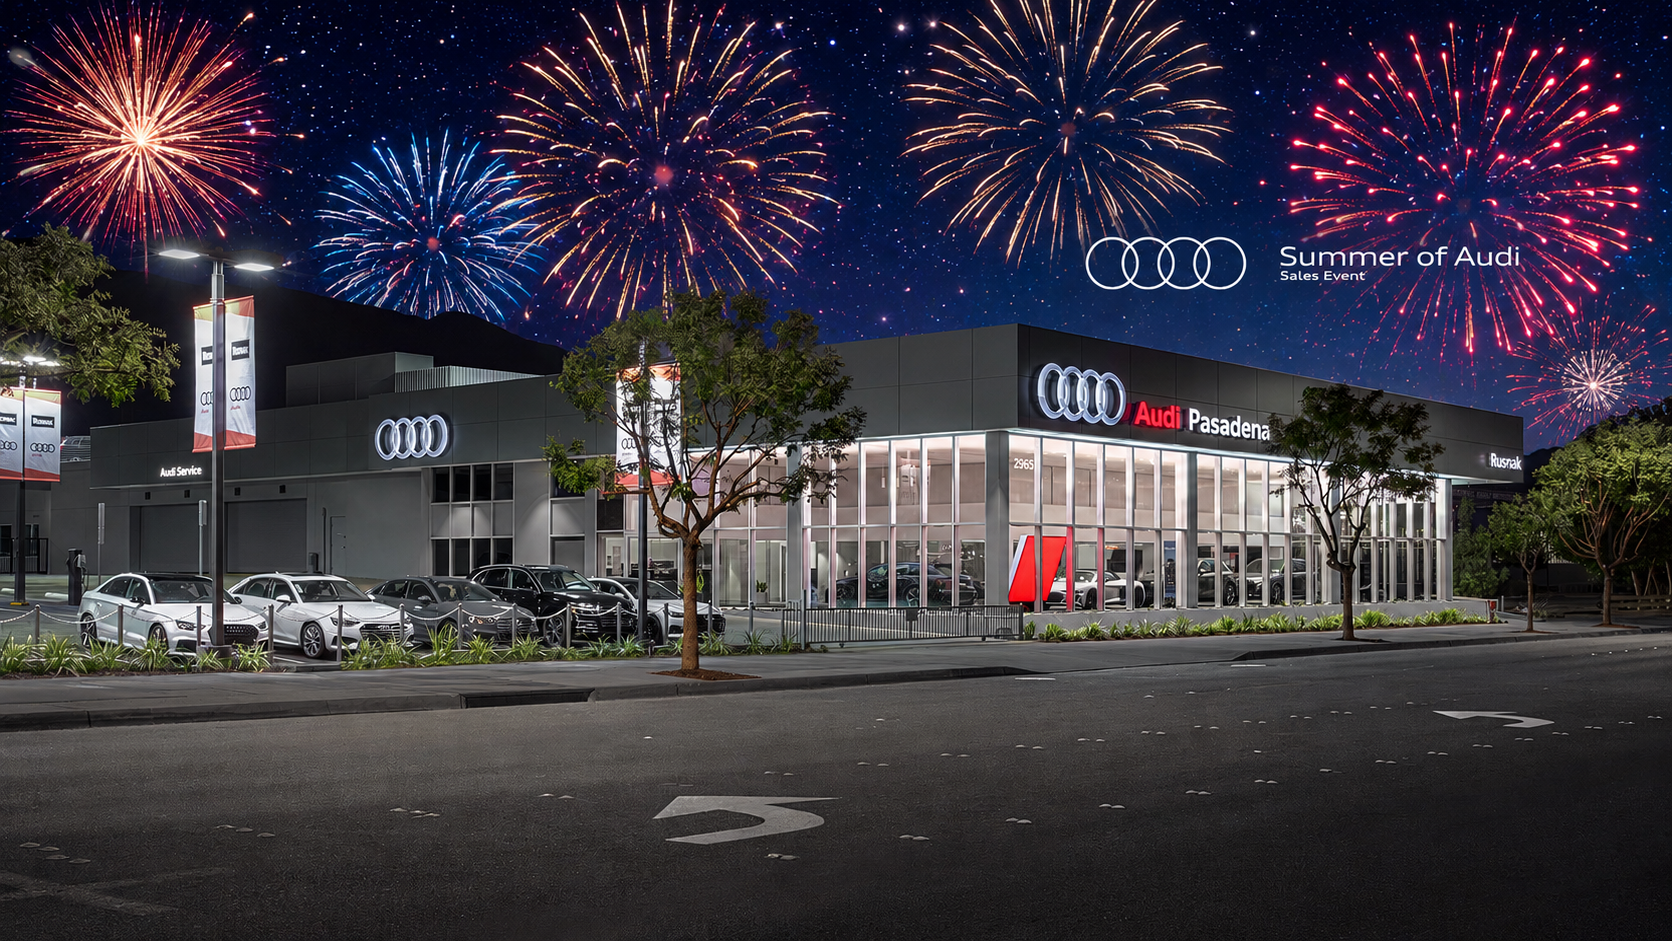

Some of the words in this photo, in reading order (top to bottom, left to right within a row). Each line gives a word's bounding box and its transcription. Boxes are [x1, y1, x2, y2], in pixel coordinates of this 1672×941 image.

[1134, 401, 1181, 430] Audi
[1188, 408, 1270, 440] Pasadena
[1013, 457, 1034, 470] 2965
[1490, 452, 1522, 470] Rusnak
[160, 467, 176, 477] Audi
[177, 465, 203, 477] Service
